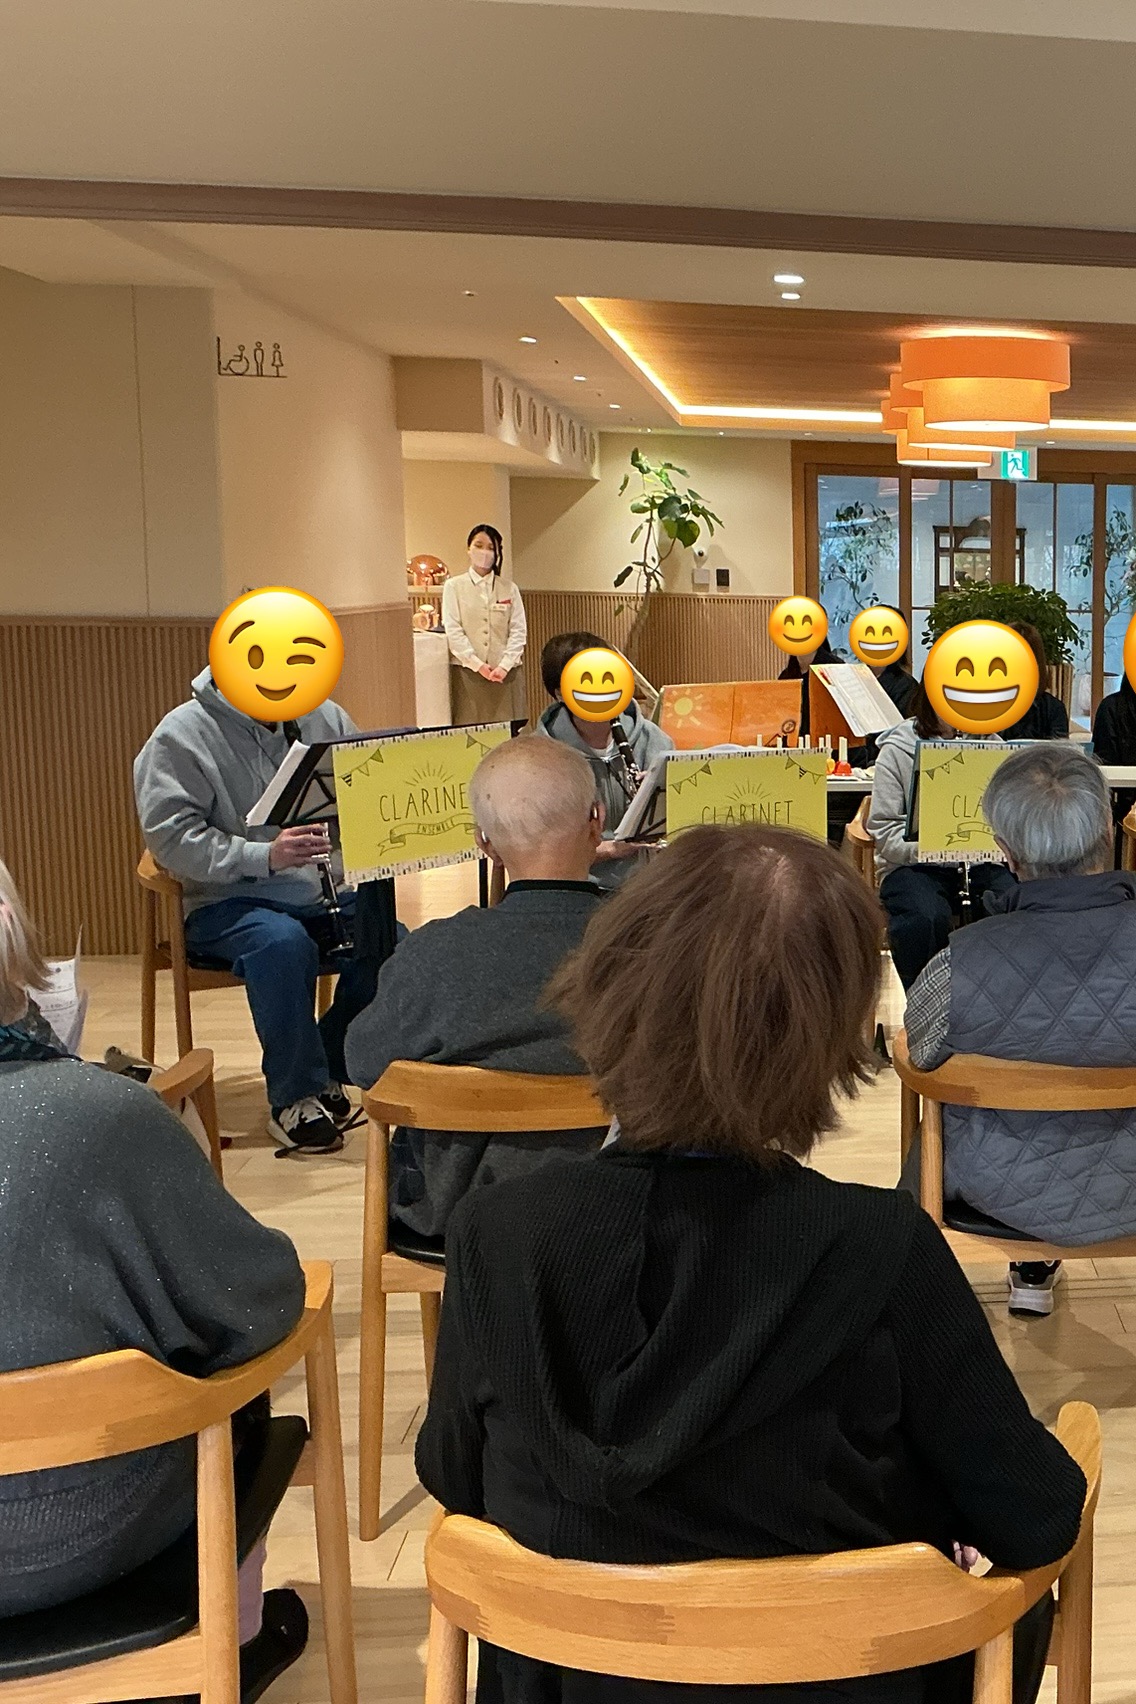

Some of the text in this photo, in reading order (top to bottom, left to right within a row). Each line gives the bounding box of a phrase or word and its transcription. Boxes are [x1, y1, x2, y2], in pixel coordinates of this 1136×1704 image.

[379, 782, 470, 822] CLARINE
[701, 800, 794, 826] CLARINET
[417, 817, 456, 834] ENSEMBLE
